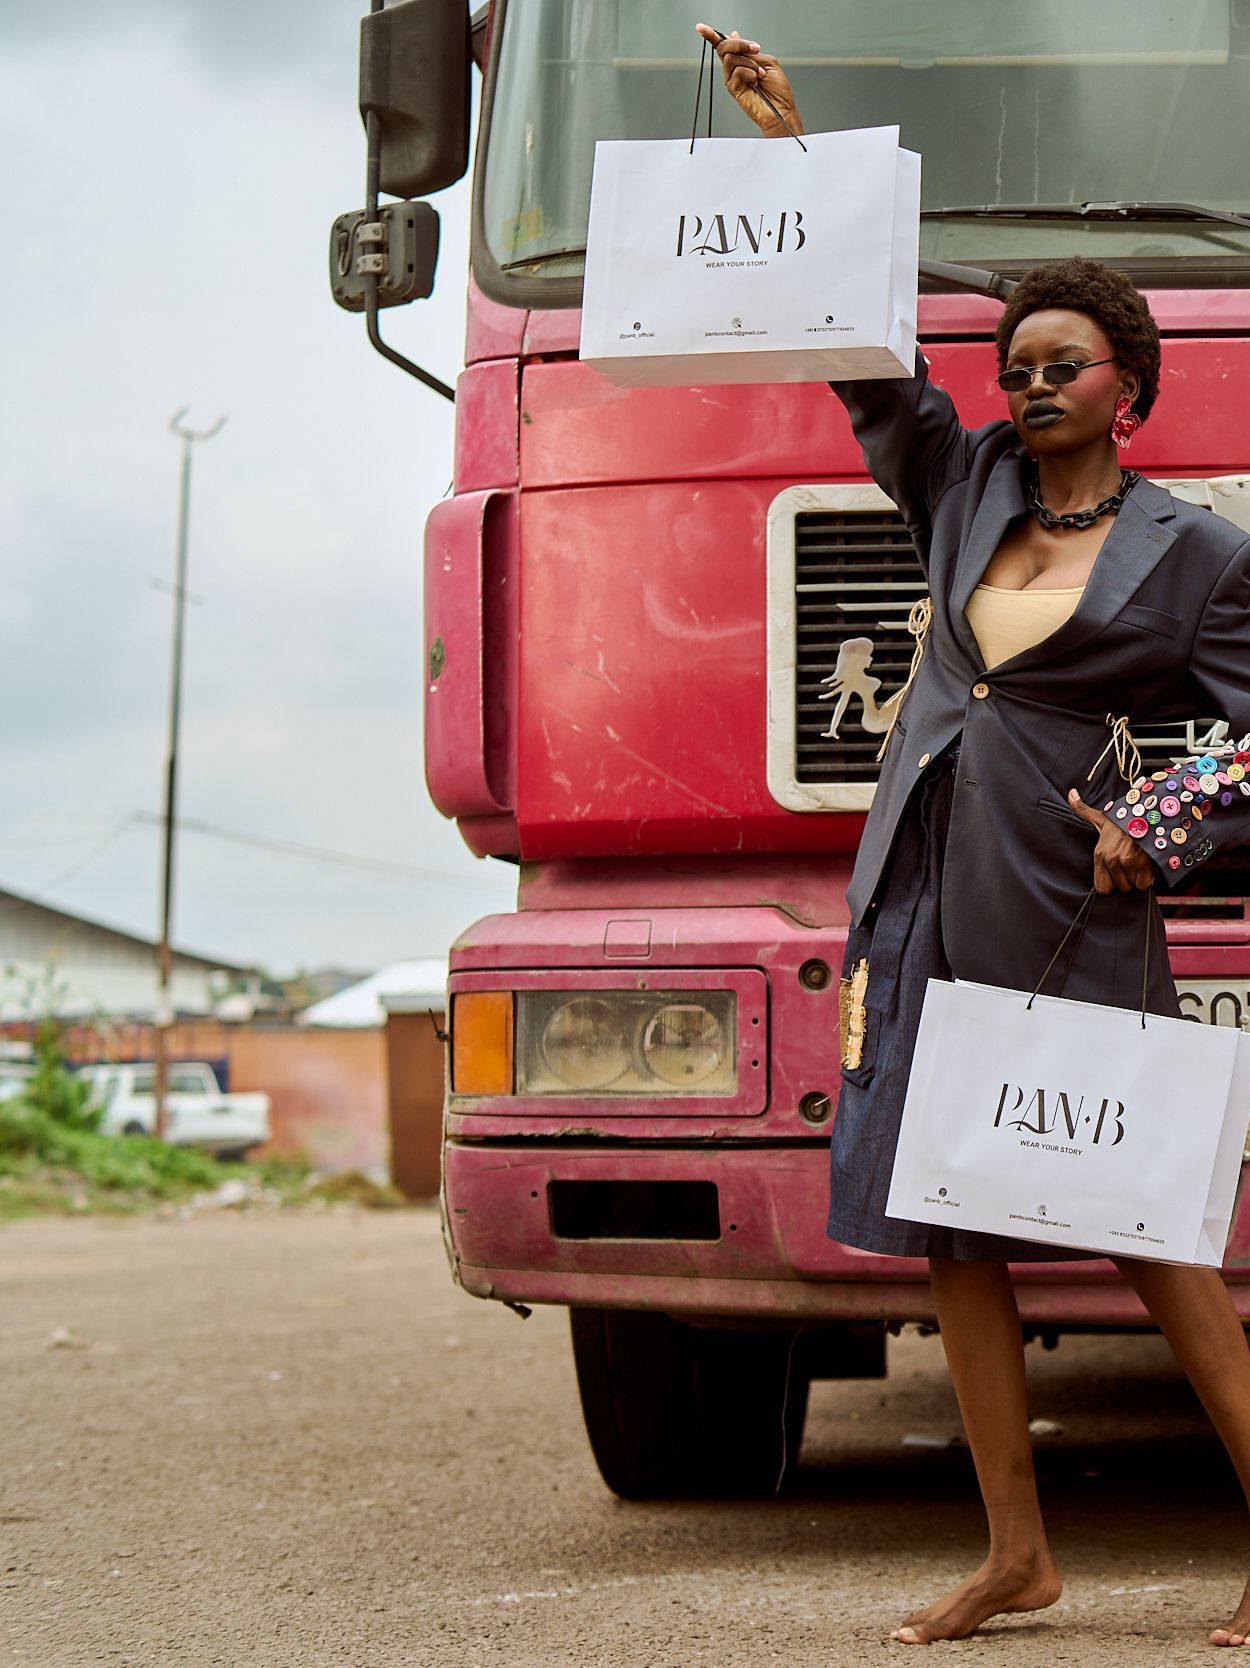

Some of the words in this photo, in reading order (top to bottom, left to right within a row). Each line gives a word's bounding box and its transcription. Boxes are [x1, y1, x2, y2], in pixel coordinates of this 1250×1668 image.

[705, 261, 725, 269] WEAR
[726, 260, 746, 268] YOUR
[746, 259, 769, 267] STORY
[619, 330, 656, 340] @panb_official
[704, 330, 768, 338] panbcontact@gmail.com
[1020, 1140, 1040, 1149] WEAR
[1041, 1143, 1060, 1152] YOUR
[1060, 1146, 1083, 1156] STORY
[923, 1196, 961, 1208] @panb_official
[1009, 1213, 1072, 1229] panbcontact@gmail.com
